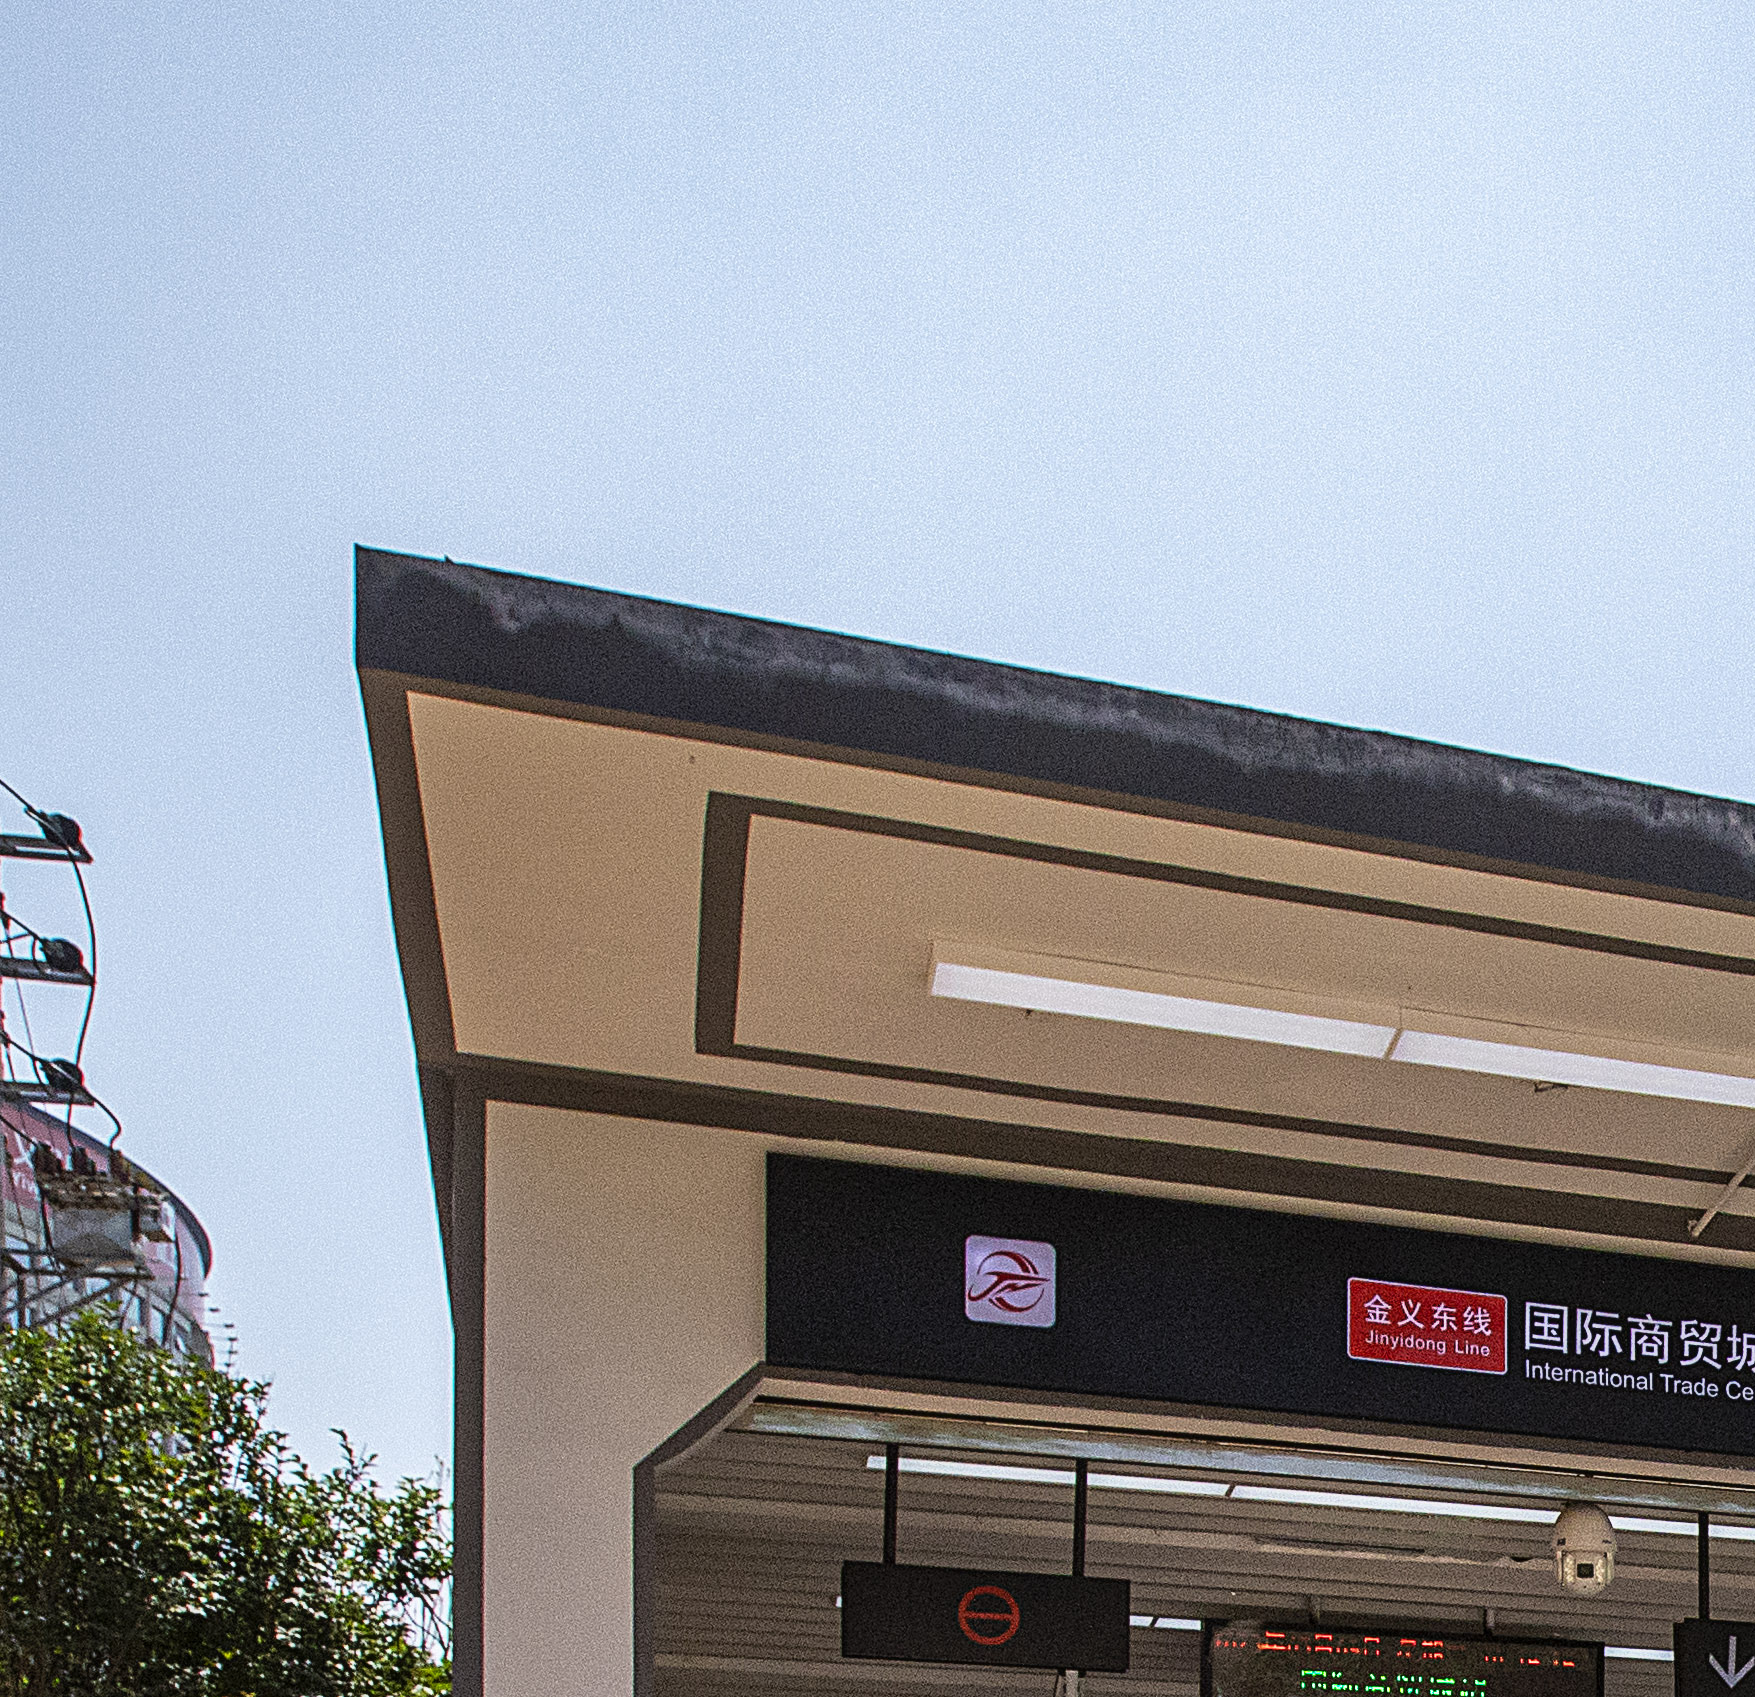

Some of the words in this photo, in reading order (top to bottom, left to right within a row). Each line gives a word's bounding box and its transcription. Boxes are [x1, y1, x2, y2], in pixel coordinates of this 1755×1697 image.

[1364, 1293, 1494, 1338] 金义东线
[1364, 1328, 1448, 1356] Jinyidong
[1454, 1338, 1492, 1358] Line
[1524, 1358, 1654, 1393] International
[1661, 1373, 1720, 1399] Trade
